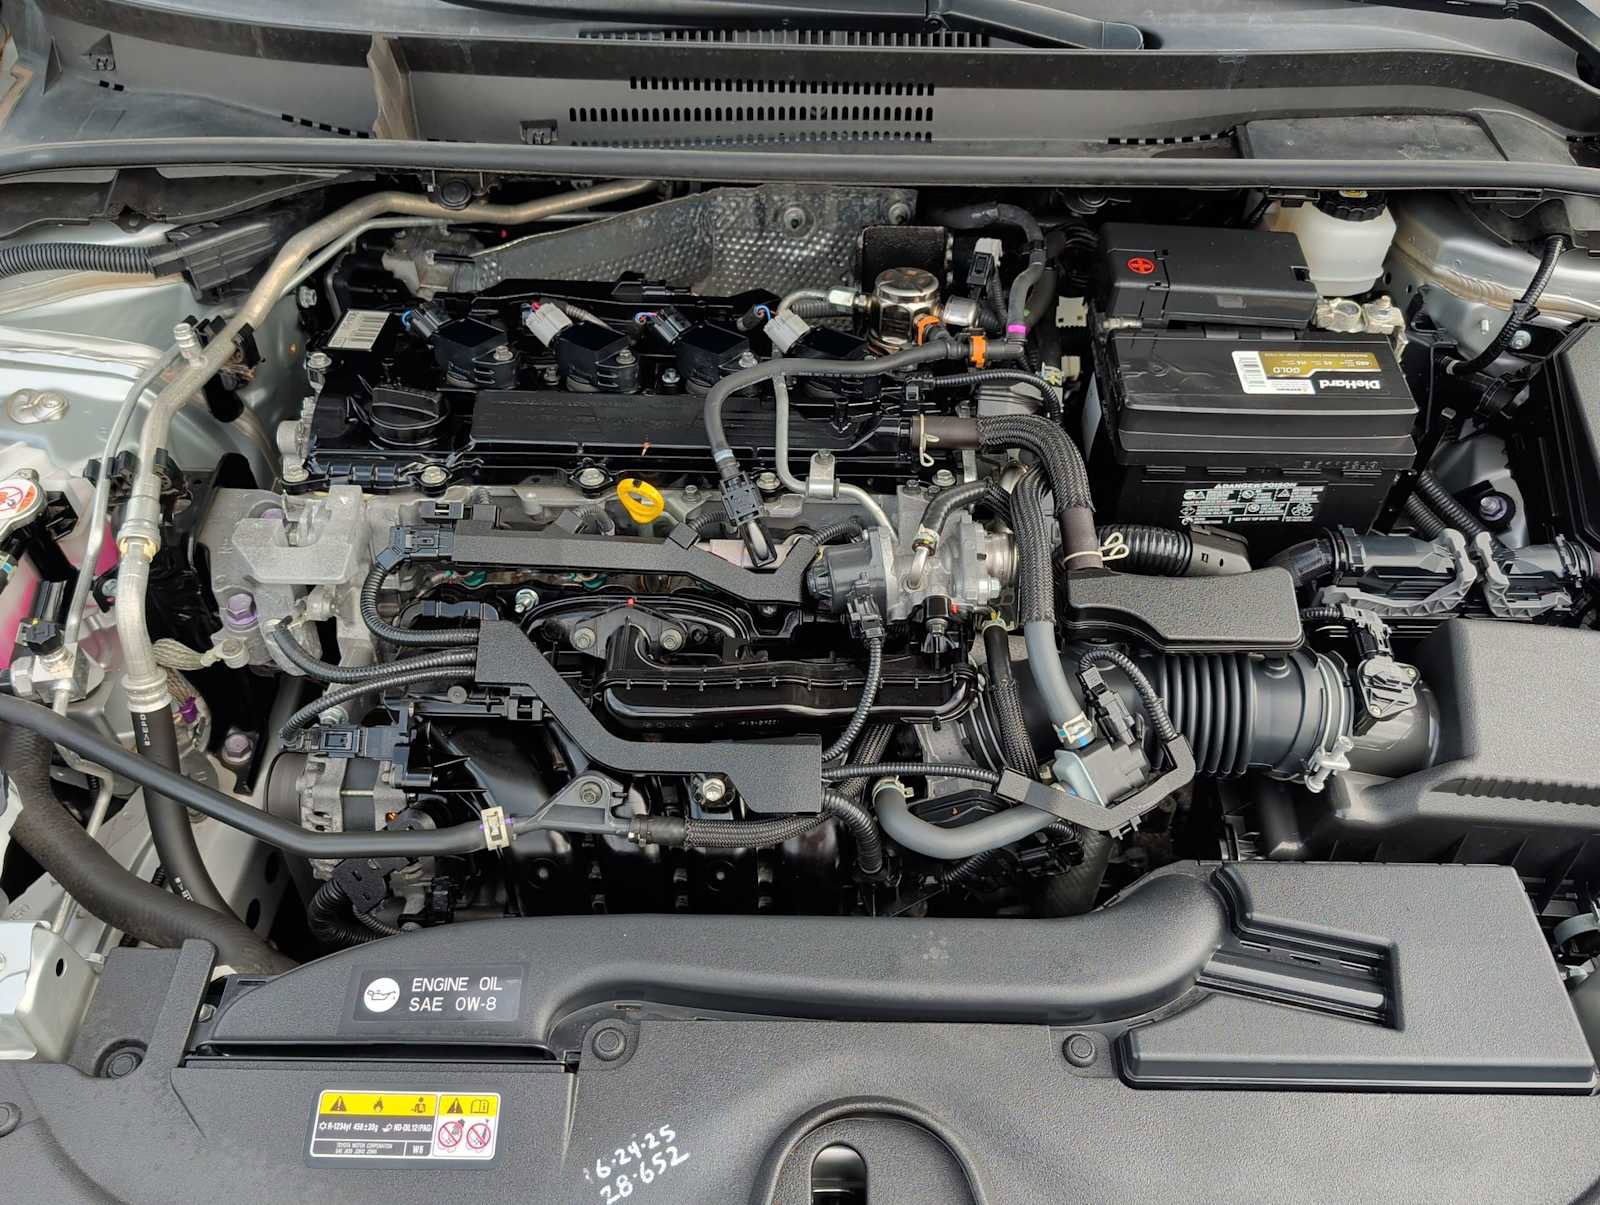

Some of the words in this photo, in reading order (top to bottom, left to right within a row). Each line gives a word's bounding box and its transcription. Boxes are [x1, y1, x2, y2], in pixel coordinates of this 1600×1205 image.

[1319, 379, 1381, 390] DieHard
[411, 977, 469, 992] ENGINE
[479, 976, 503, 991] OIL
[408, 996, 444, 1012] SAE
[455, 996, 497, 1011] 0W-8
